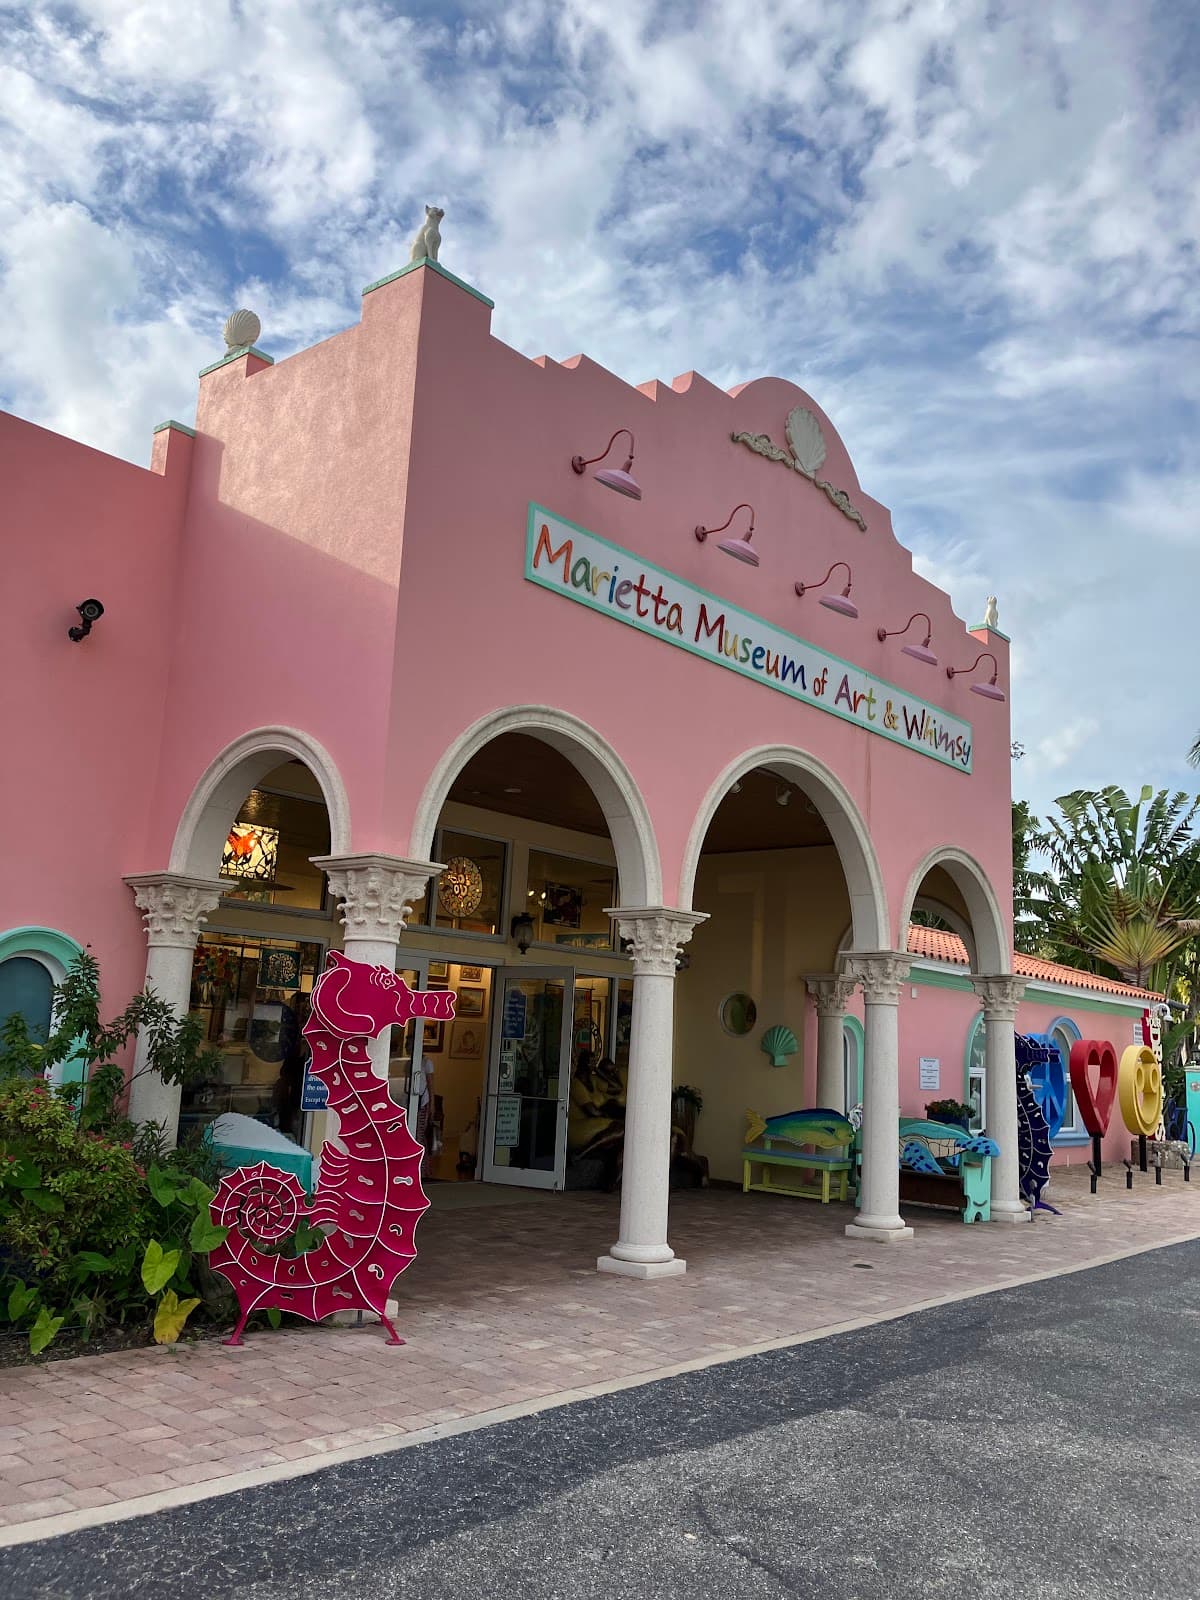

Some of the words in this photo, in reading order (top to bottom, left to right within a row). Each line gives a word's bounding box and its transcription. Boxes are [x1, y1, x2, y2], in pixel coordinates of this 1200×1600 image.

[533, 524, 684, 635] Marietta
[694, 603, 807, 690] Museum
[813, 667, 828, 696] of
[834, 674, 876, 720] Art
[883, 700, 899, 730] &
[903, 705, 971, 765] Whimsy
